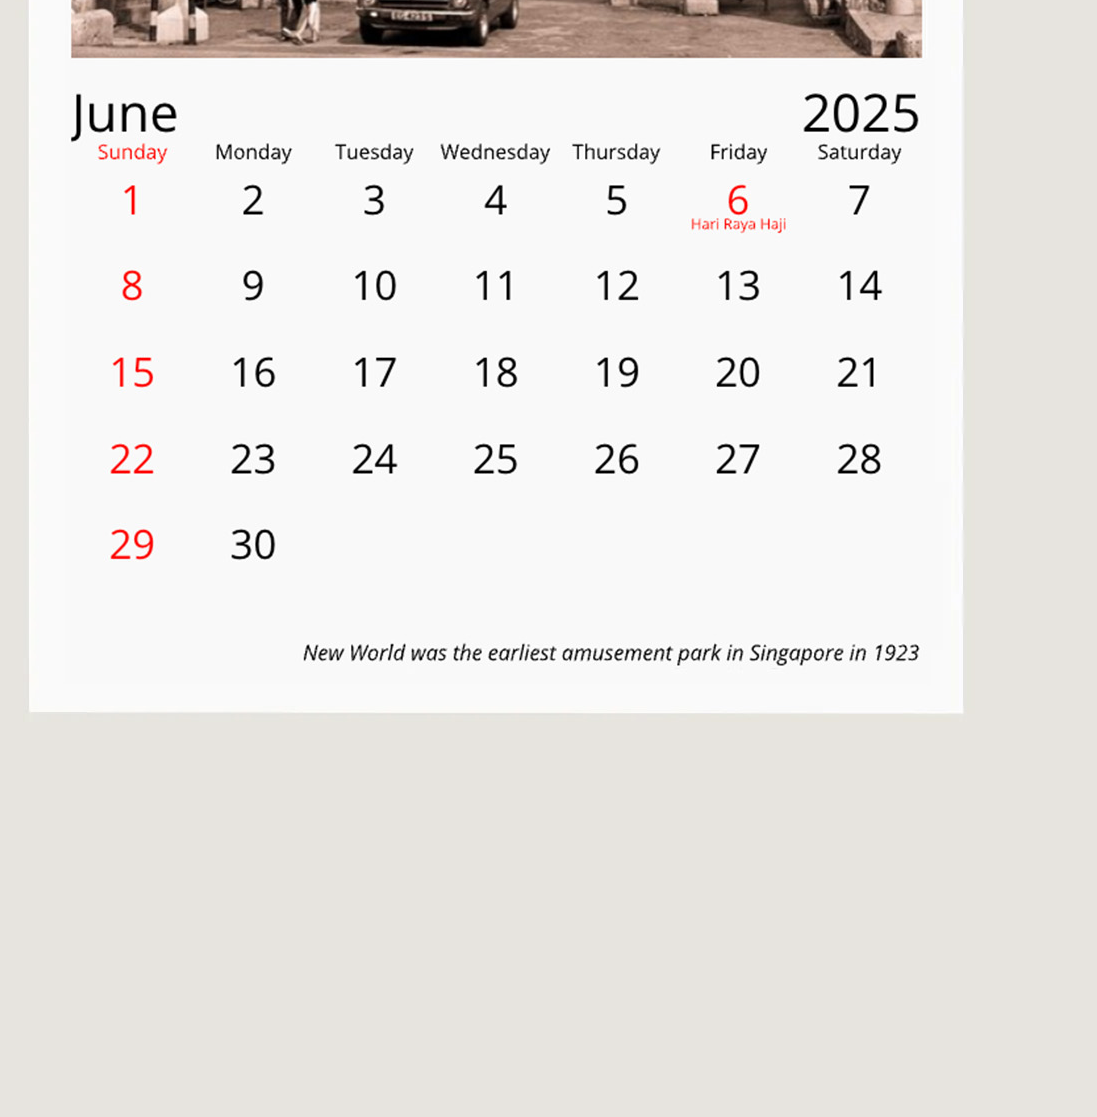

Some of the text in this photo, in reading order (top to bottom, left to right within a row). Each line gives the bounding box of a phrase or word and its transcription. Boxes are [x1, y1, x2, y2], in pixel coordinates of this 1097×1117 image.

[71, 93, 918, 142] June 2025
[98, 143, 901, 164] Sunday Monday Tuesday Wednesday Thursday Friday Saturday
[124, 185, 870, 215] 1 2 3 4 5 6 7
[692, 218, 786, 233] Hari Raya Haji
[122, 270, 882, 301] 8 9 10 11 12 13 14
[113, 357, 874, 387] 15 16 17 18 19 20 21
[111, 444, 881, 474] 22 23 24 25 26 27 28
[111, 529, 275, 560] 29 30
[304, 643, 919, 666] New World was the earliest amusement park in Singapore in 1923
